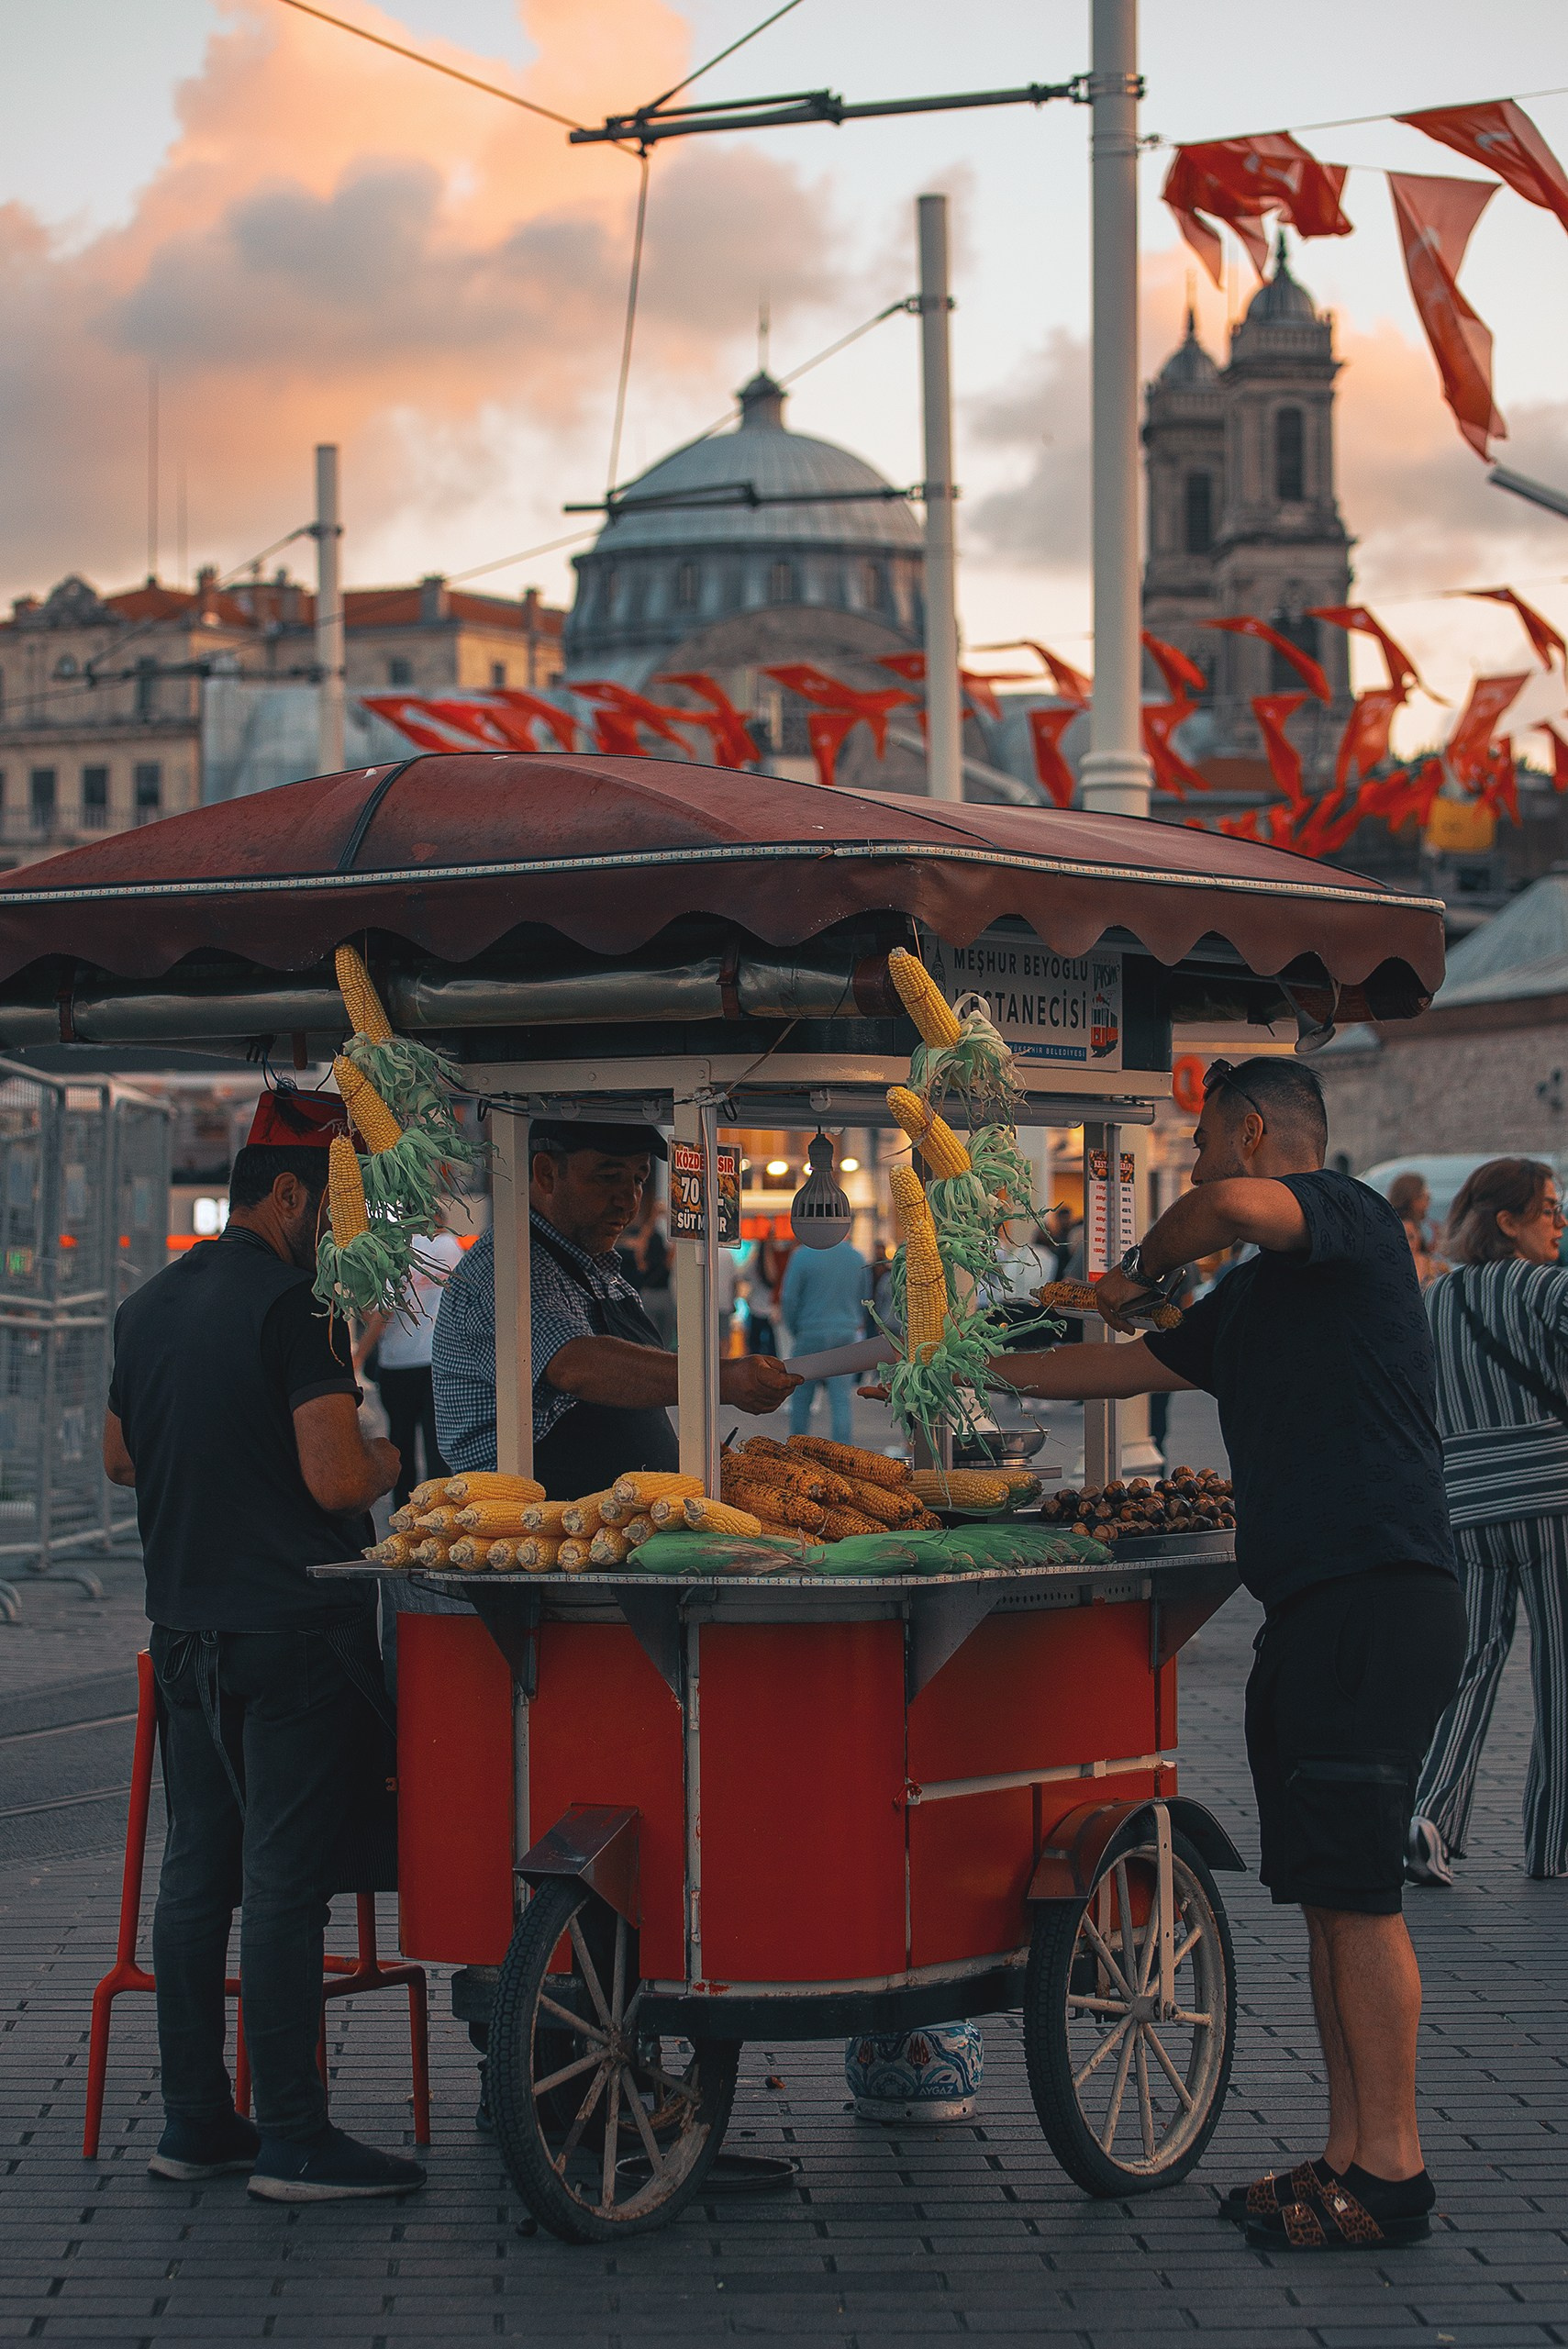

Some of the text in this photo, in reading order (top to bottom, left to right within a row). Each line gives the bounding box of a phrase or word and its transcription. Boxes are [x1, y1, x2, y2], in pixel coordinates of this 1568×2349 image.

[954, 947, 1017, 978] MEŞHUR
[681, 1176, 700, 1204] 70
[677, 1208, 696, 1230] SÜT
[919, 2085, 954, 2096] AYGAZ
